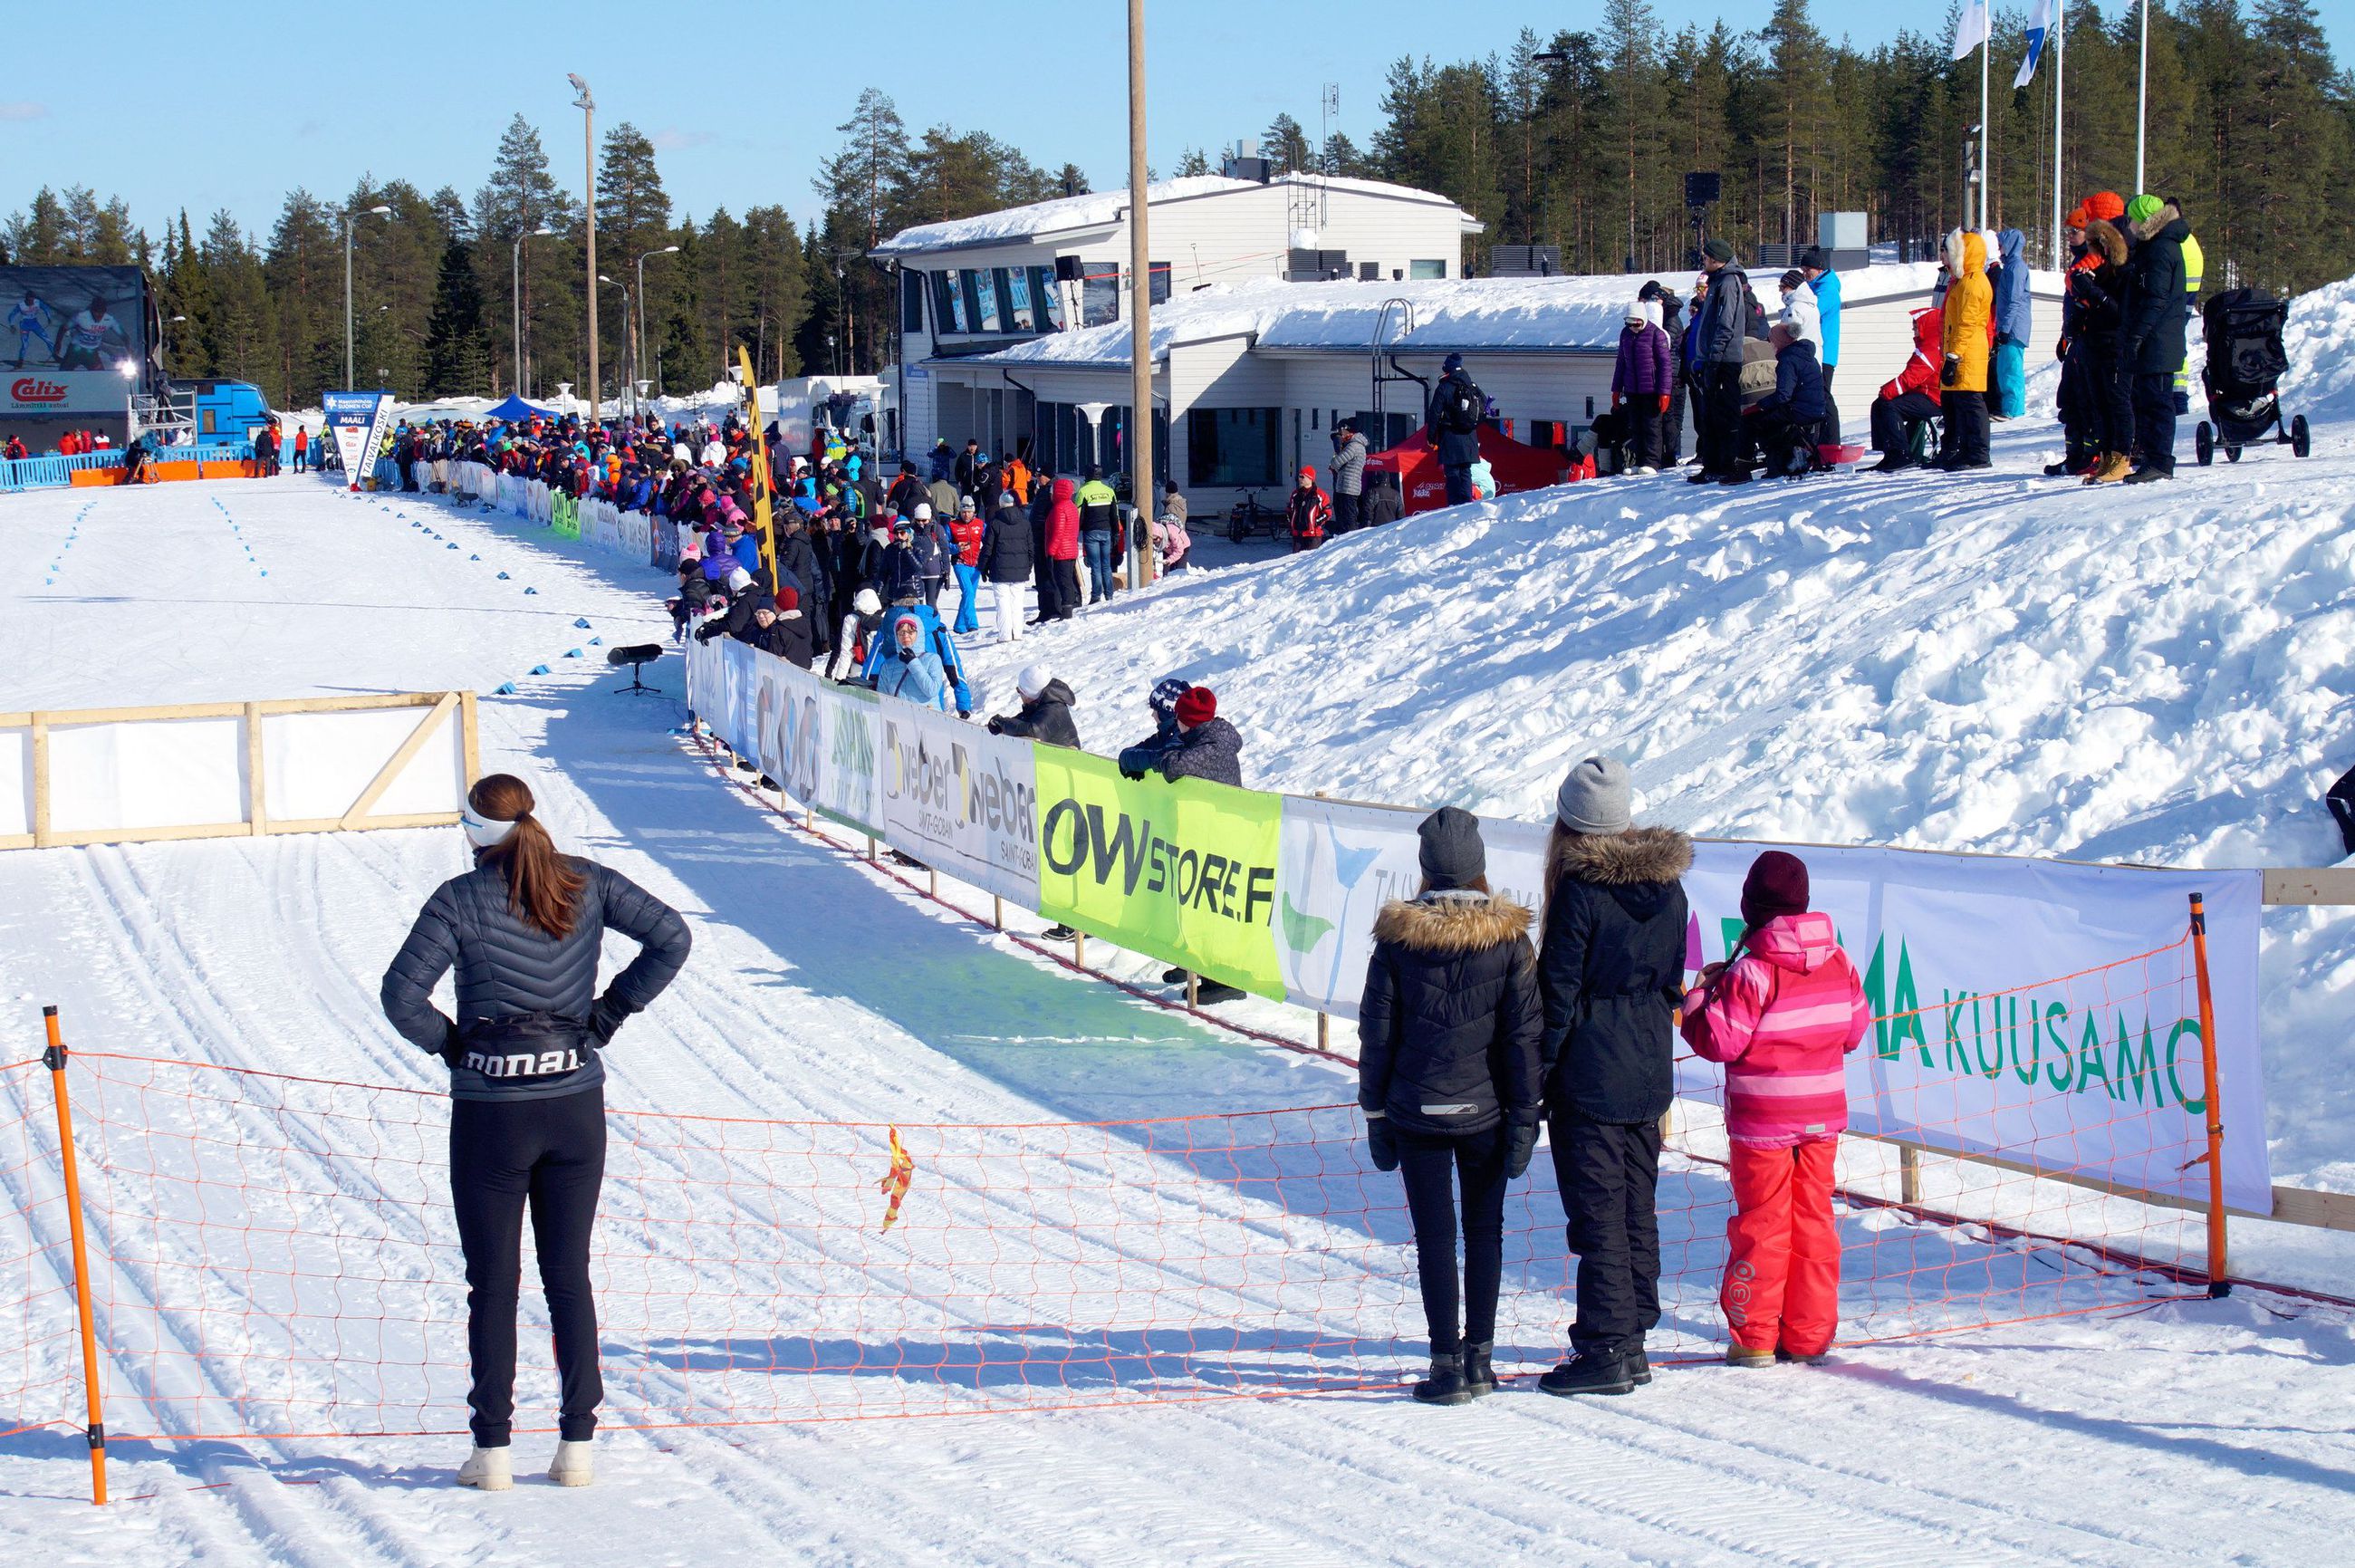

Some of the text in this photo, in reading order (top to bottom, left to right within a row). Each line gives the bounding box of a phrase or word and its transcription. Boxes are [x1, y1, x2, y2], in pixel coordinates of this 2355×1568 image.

[11, 378, 69, 401] Calix
[363, 409, 389, 473] TAIVALKOSKI
[967, 755, 1035, 843] weber
[1944, 988, 2208, 1115] KUUSAMO
